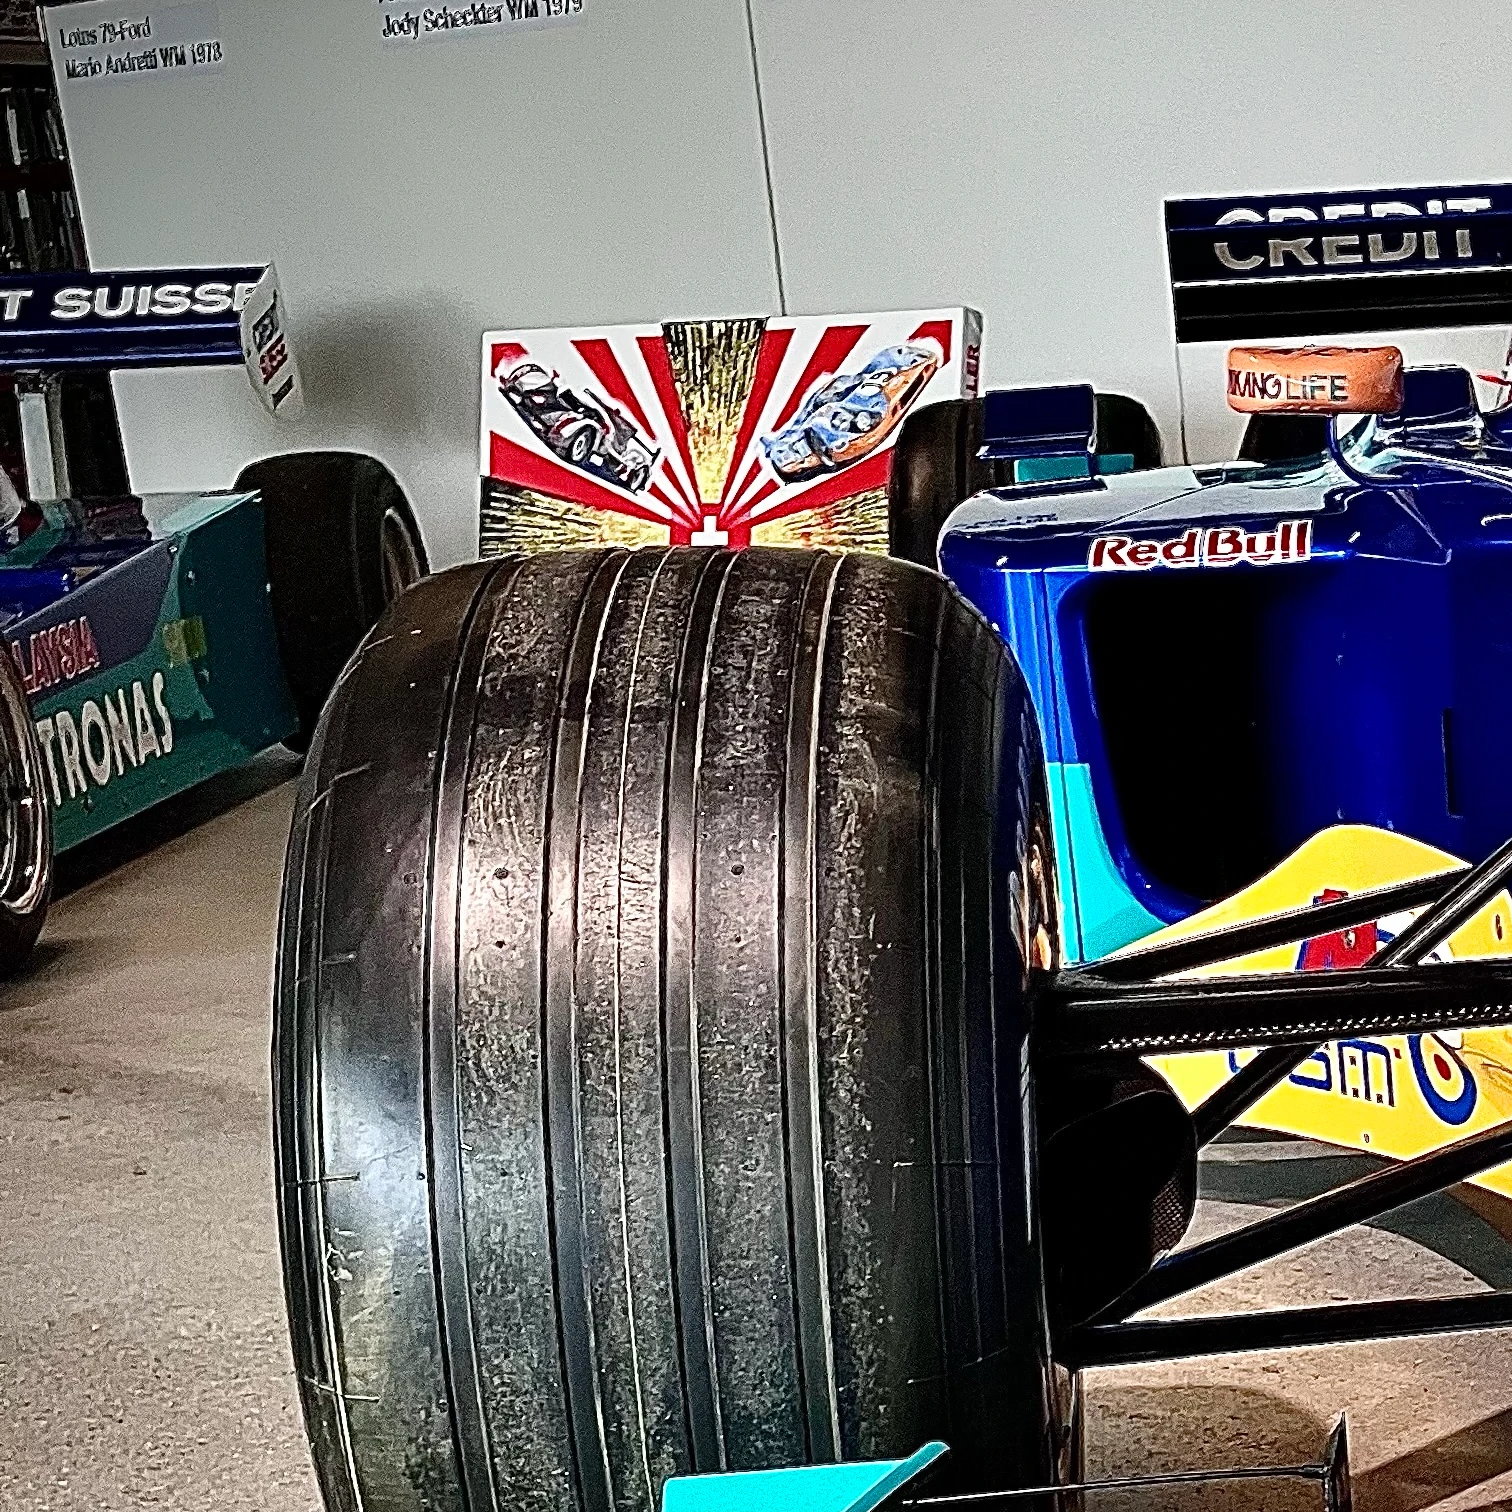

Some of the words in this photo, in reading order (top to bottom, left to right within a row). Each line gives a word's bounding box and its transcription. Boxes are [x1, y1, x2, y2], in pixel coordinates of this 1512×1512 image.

[382, 12, 419, 40] Jody
[65, 57, 102, 79] Mario
[105, 48, 158, 75] Andretti
[189, 40, 223, 64] 1978
[1286, 374, 1349, 402] LIFE
[1089, 528, 1201, 573] Red
[1203, 520, 1312, 567] Bull
[36, 672, 173, 806] TRONAS
